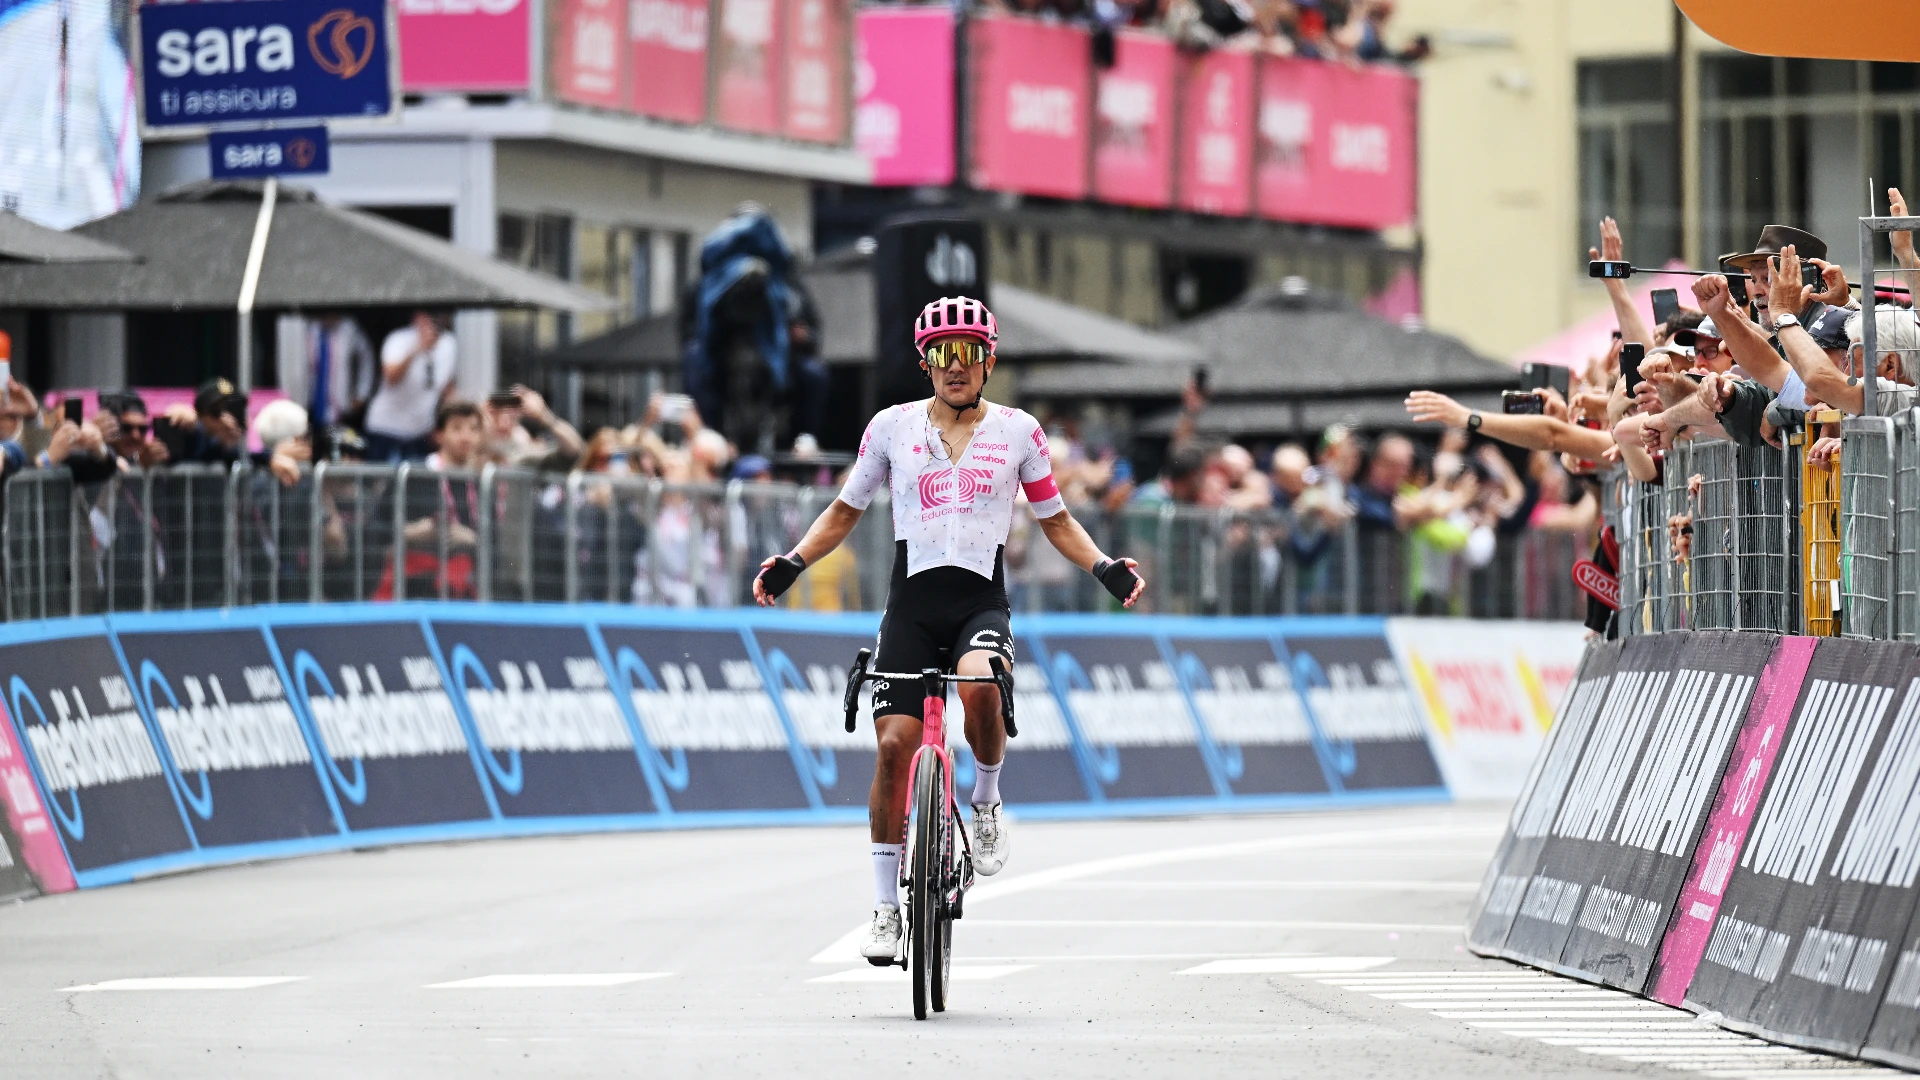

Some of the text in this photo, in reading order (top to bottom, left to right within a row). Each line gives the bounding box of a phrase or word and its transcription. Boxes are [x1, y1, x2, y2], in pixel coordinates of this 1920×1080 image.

[156, 24, 295, 78] sara
[160, 83, 297, 116] ti assicura
[224, 142, 283, 169] sara
[973, 442, 1009, 451] easypost
[973, 454, 1006, 465] wahoo
[922, 506, 973, 523] Education
[1583, 566, 1620, 602] OYOTA
